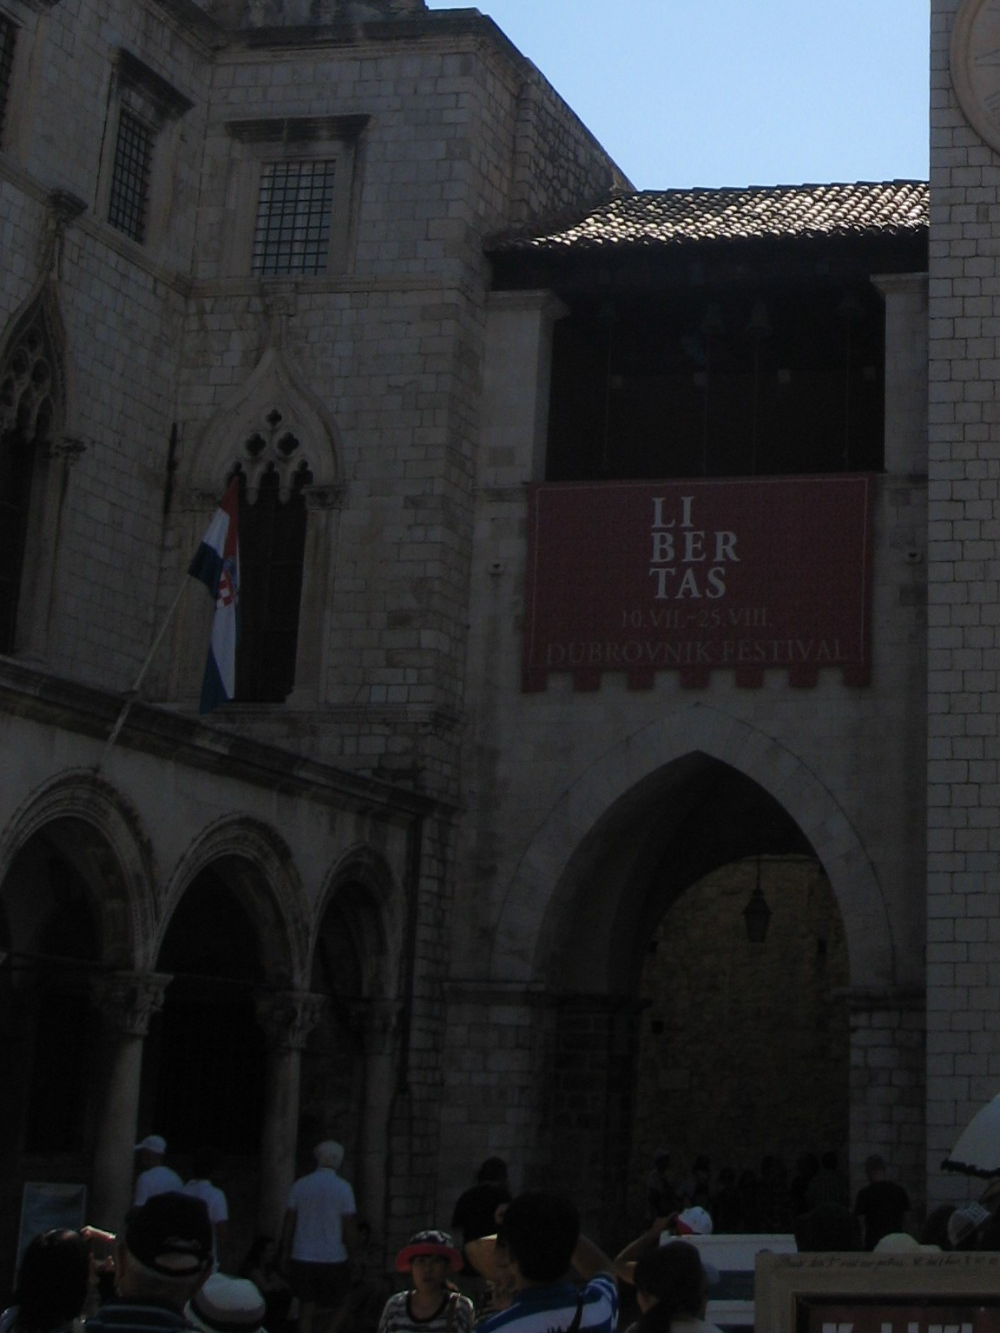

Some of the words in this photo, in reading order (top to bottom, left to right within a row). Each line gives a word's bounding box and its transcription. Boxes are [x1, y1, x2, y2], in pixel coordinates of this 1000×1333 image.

[651, 496, 696, 529] LI
[650, 530, 742, 564] BER
[649, 567, 727, 600] TAS
[546, 640, 714, 665] DUBROVNIK
[723, 638, 849, 662] FESTIVAL
